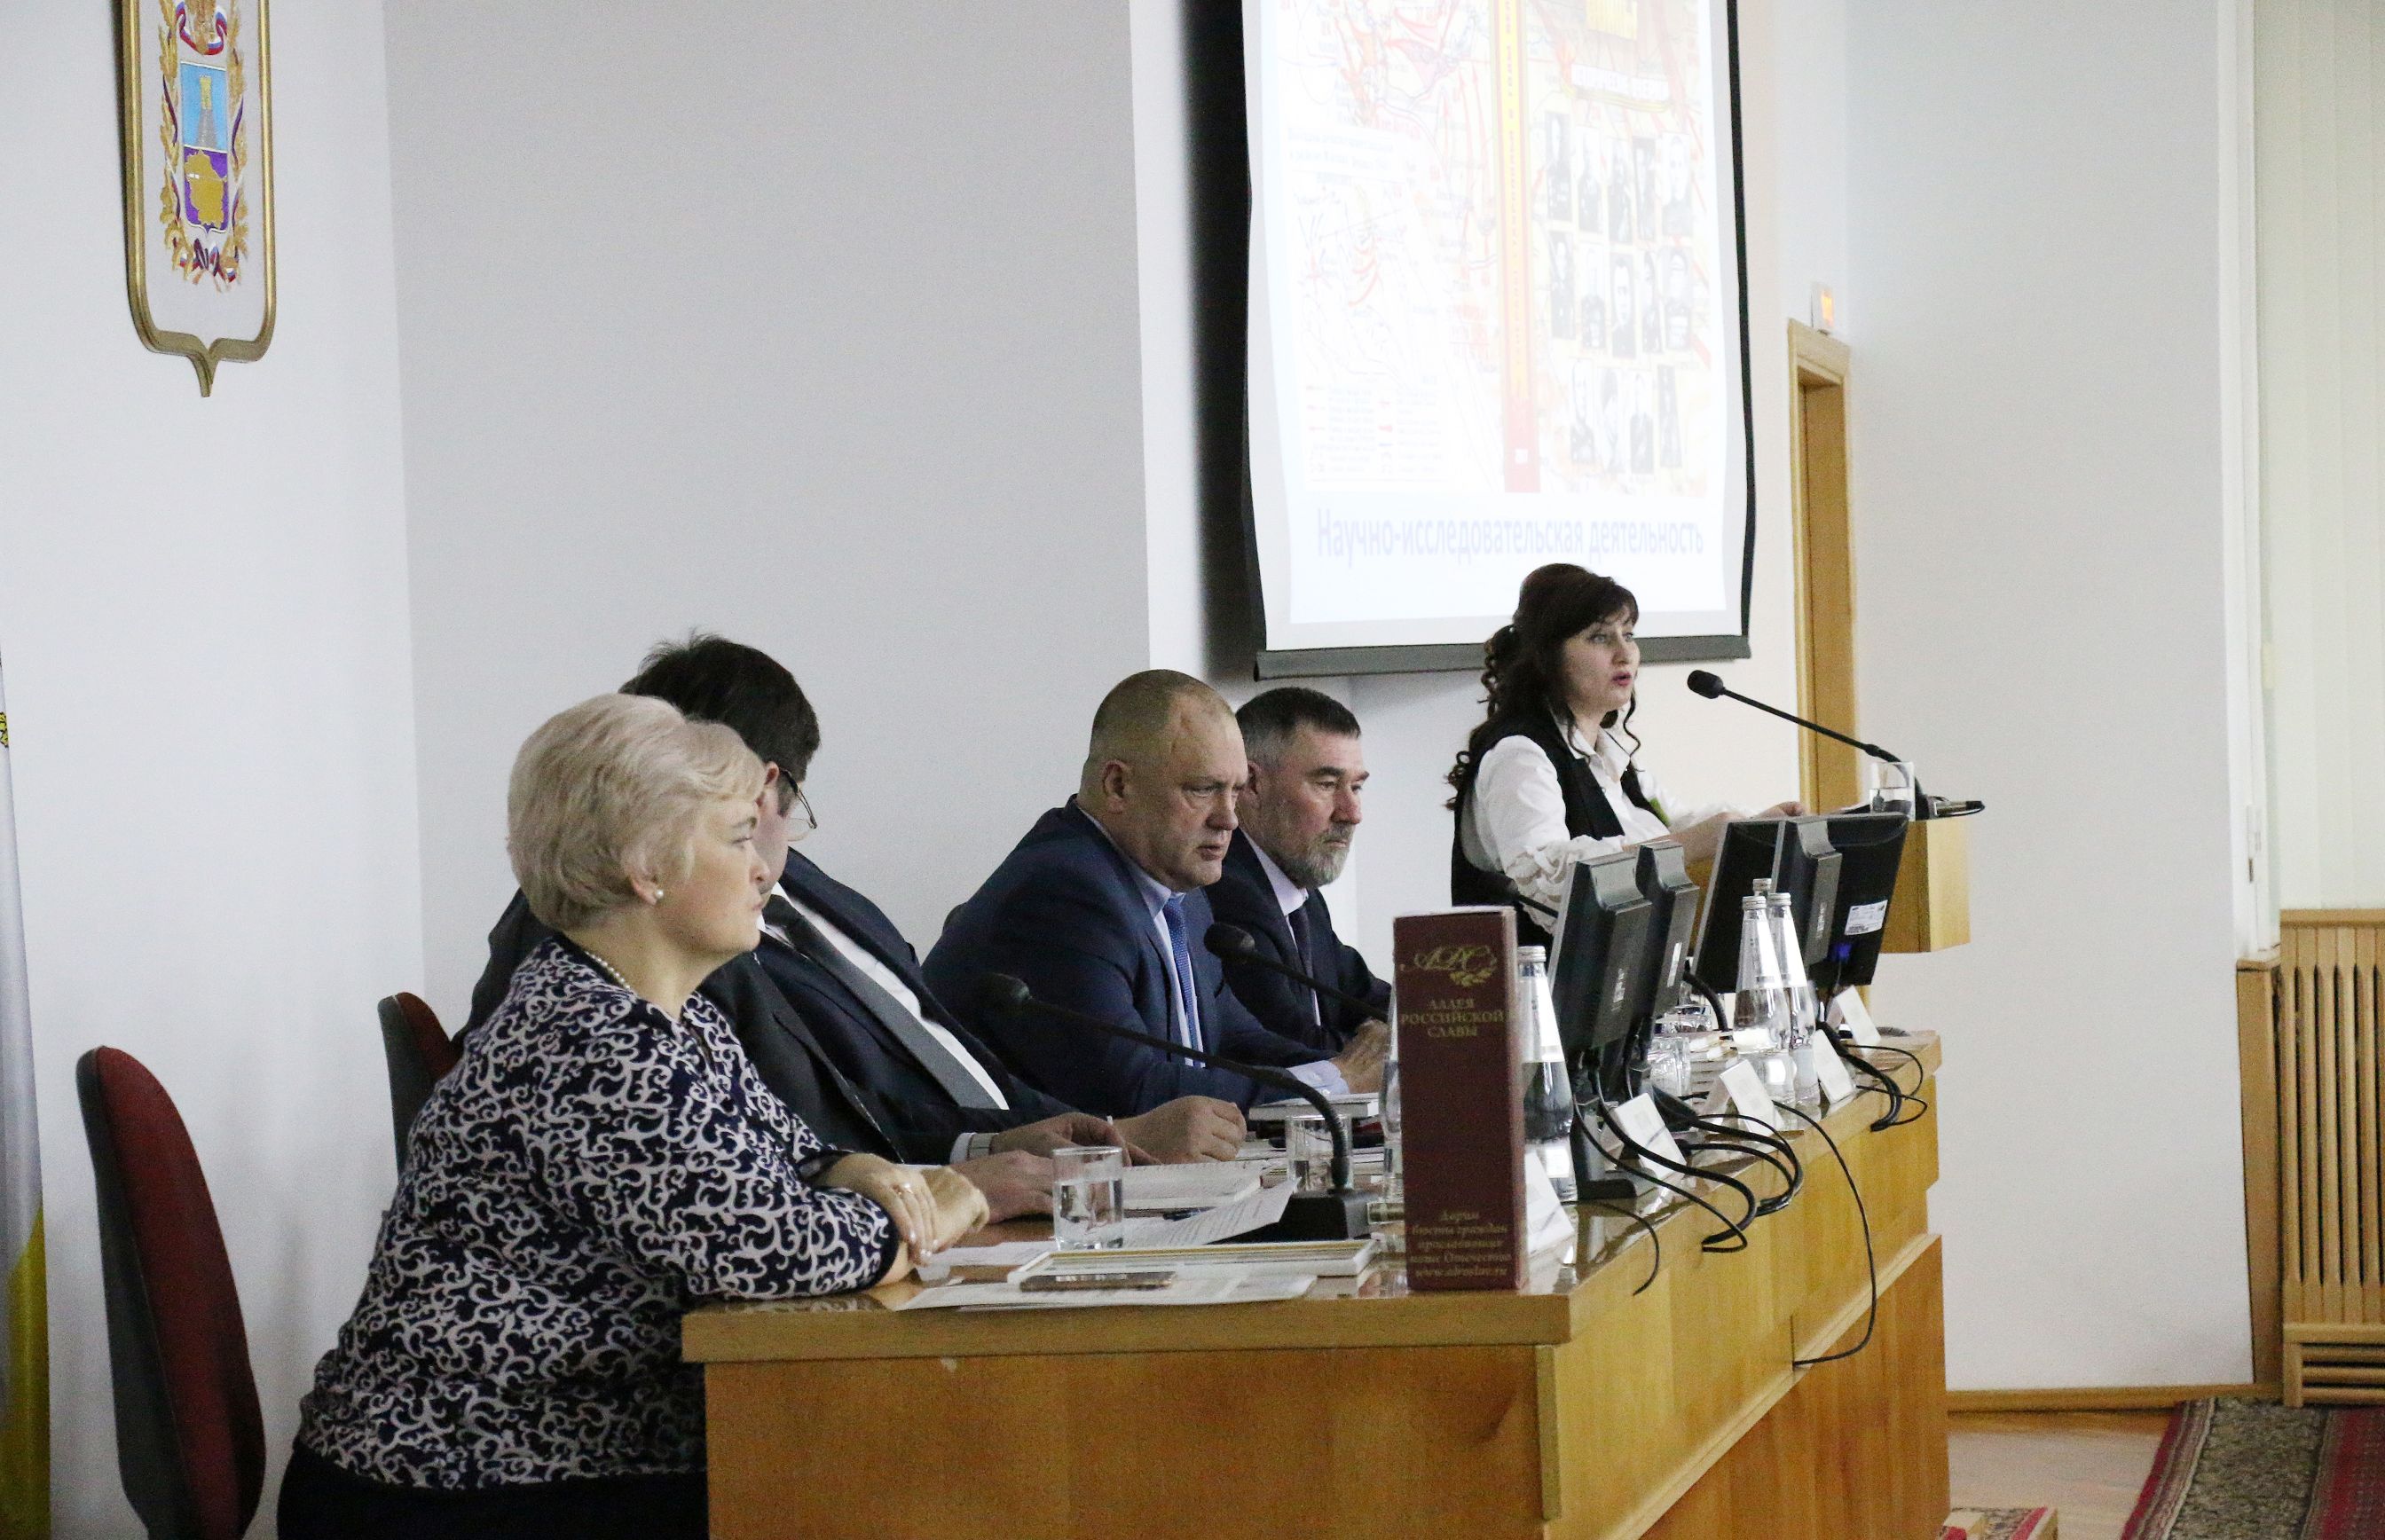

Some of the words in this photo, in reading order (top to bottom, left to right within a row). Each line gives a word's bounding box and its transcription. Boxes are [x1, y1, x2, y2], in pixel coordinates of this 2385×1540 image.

[1317, 507, 1584, 568] Научно-исследовательская
[1588, 518, 1704, 563] деятельность
[1401, 1010, 1504, 1025] РОССИЙСКОЙ
[1428, 1026, 1477, 1038] СЛАВЫ
